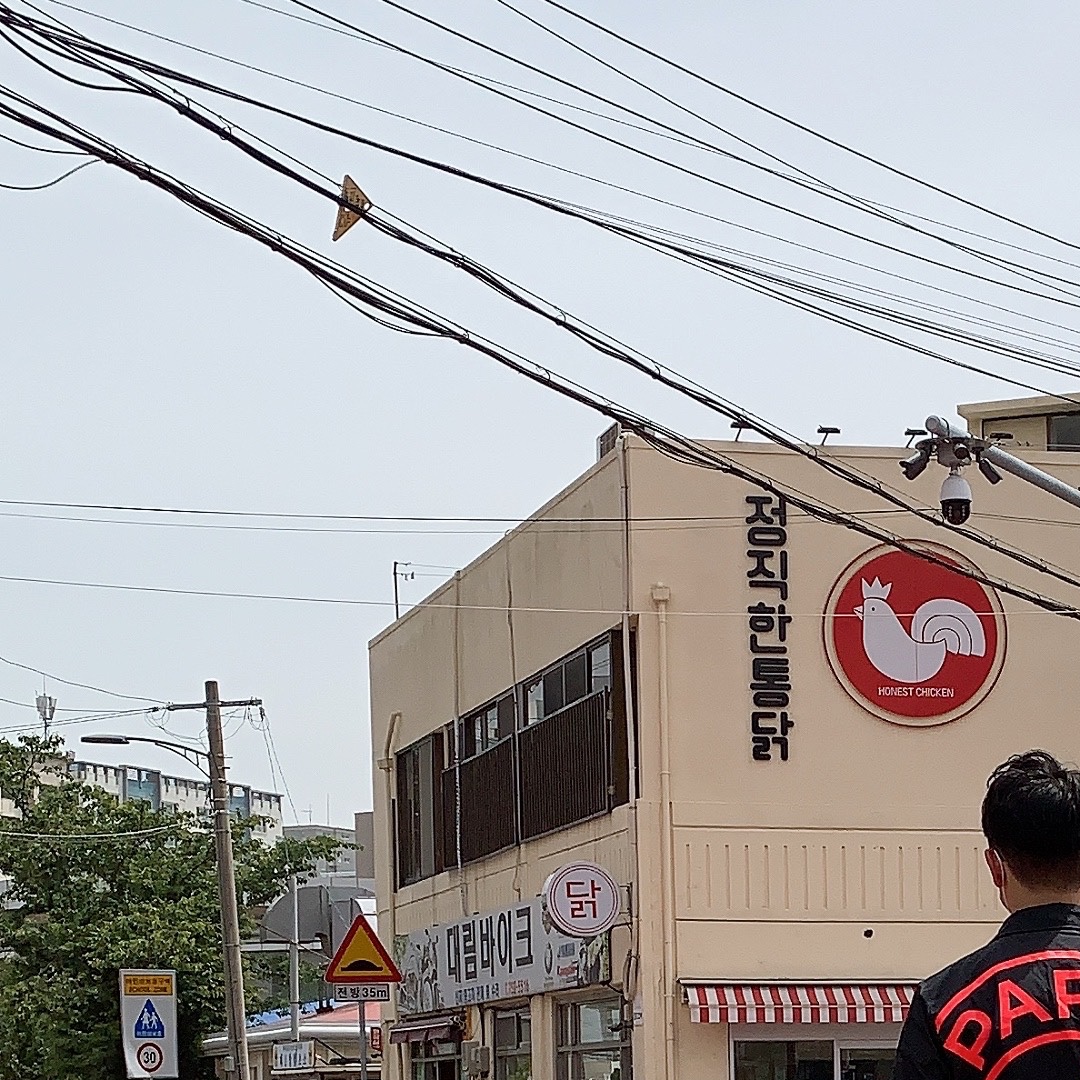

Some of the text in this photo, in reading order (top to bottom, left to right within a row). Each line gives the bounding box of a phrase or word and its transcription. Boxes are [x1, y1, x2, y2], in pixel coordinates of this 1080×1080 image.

[745, 495, 795, 761] 정직한통닭
[877, 686, 954, 698] HONEST CHICKEN
[565, 879, 602, 919] 닭
[446, 905, 534, 984] 대림바이크
[143, 1051, 156, 1064] 30
